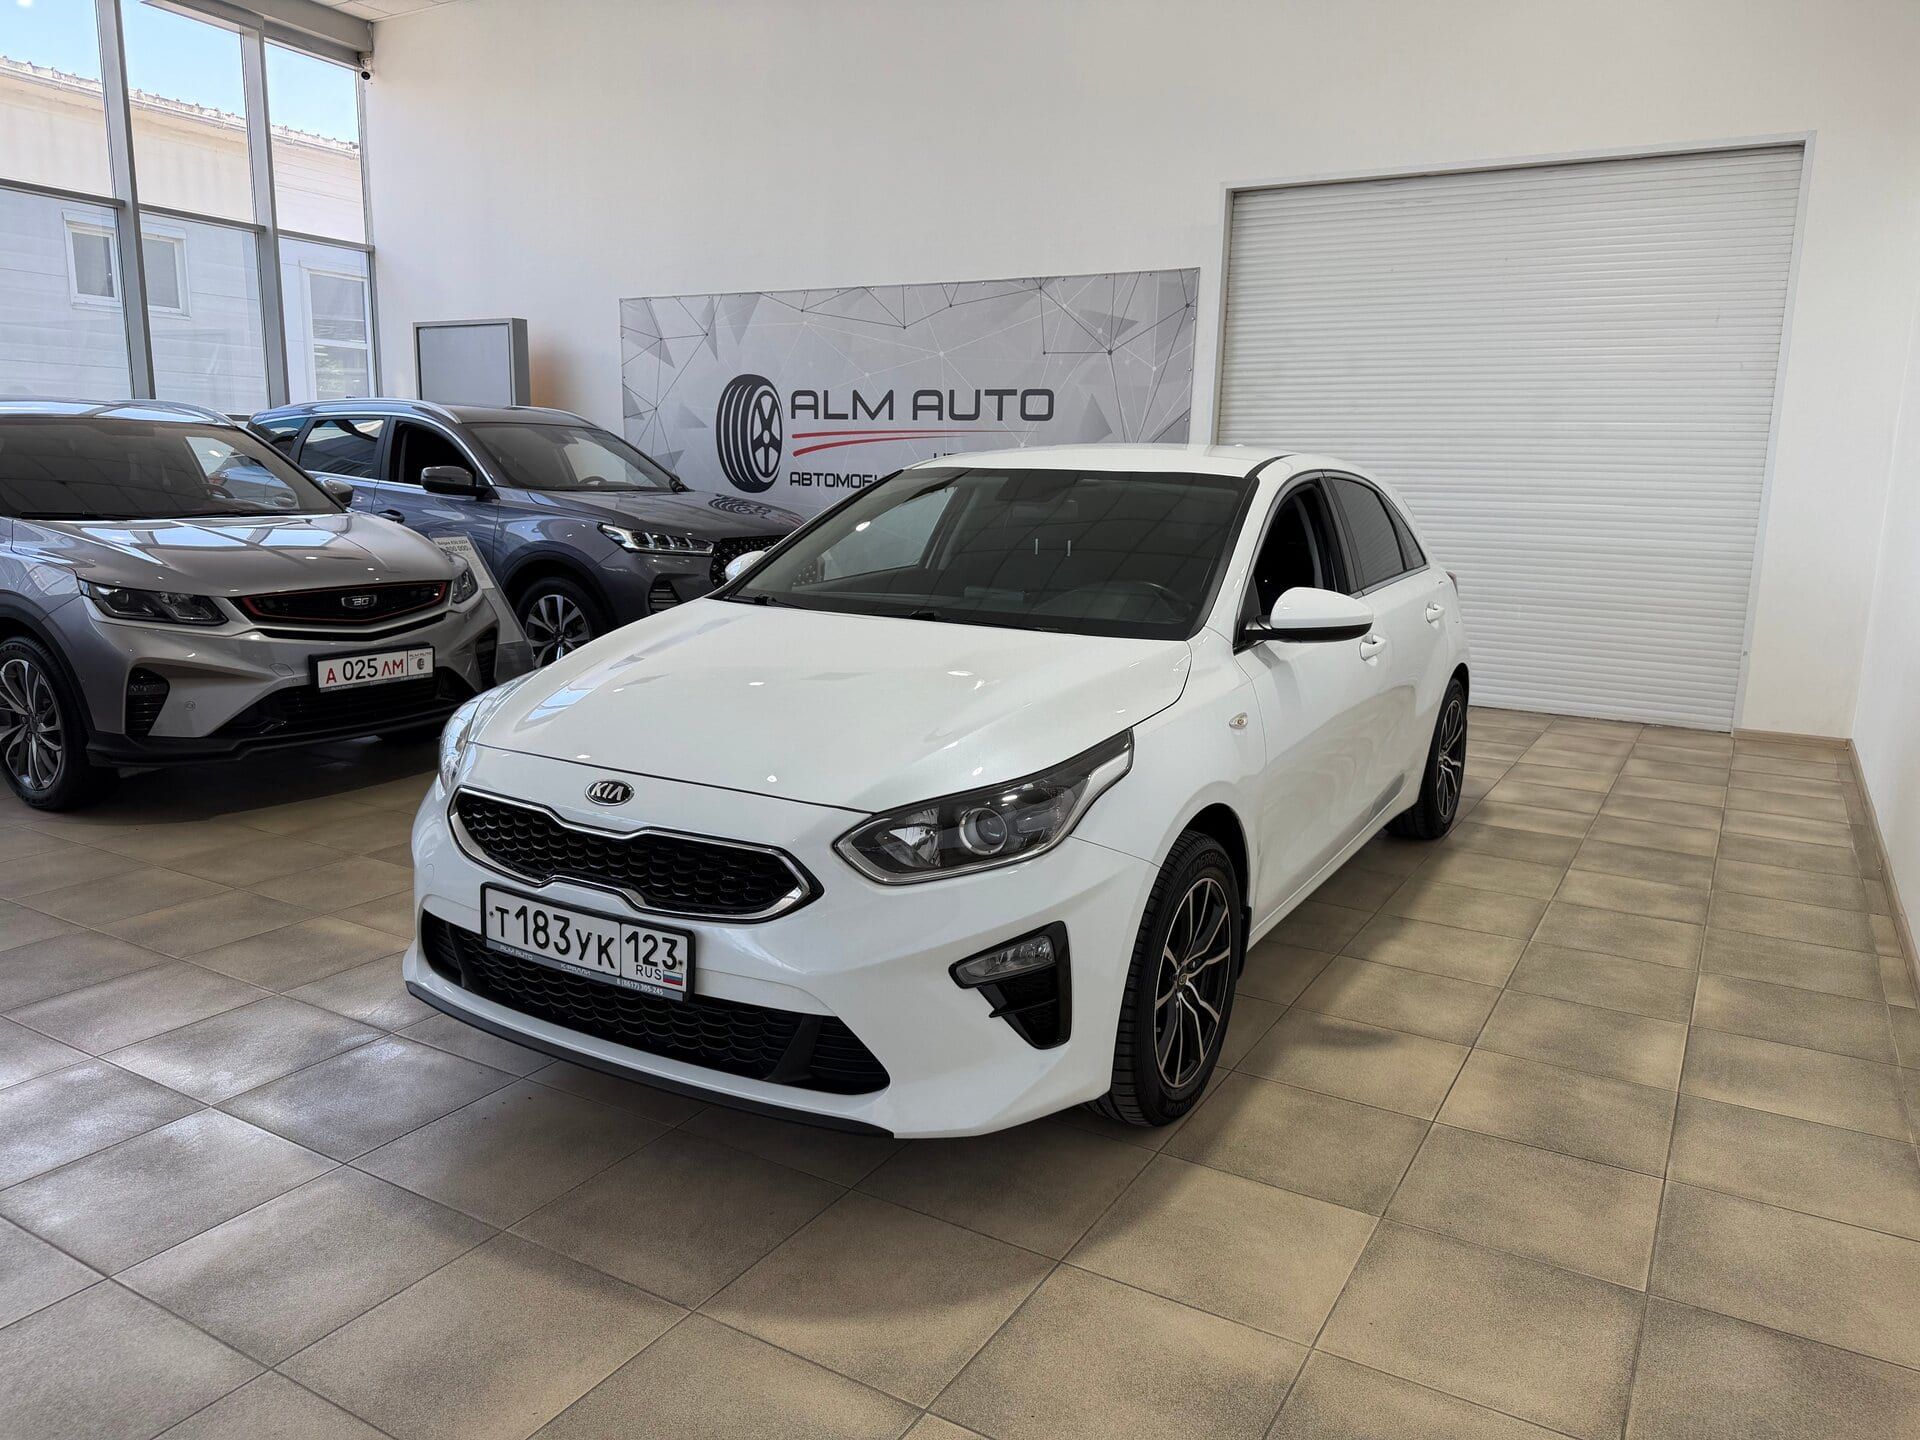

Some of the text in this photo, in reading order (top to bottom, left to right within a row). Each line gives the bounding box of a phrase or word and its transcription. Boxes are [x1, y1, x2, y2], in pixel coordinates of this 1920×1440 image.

[791, 388, 1055, 421] ALM AUTO
[790, 471, 878, 488] АВТОМОБ
[343, 658, 378, 681] 025
[591, 782, 624, 801] KIA
[495, 905, 679, 971] Т183УК 123
[635, 964, 662, 980] RUS
